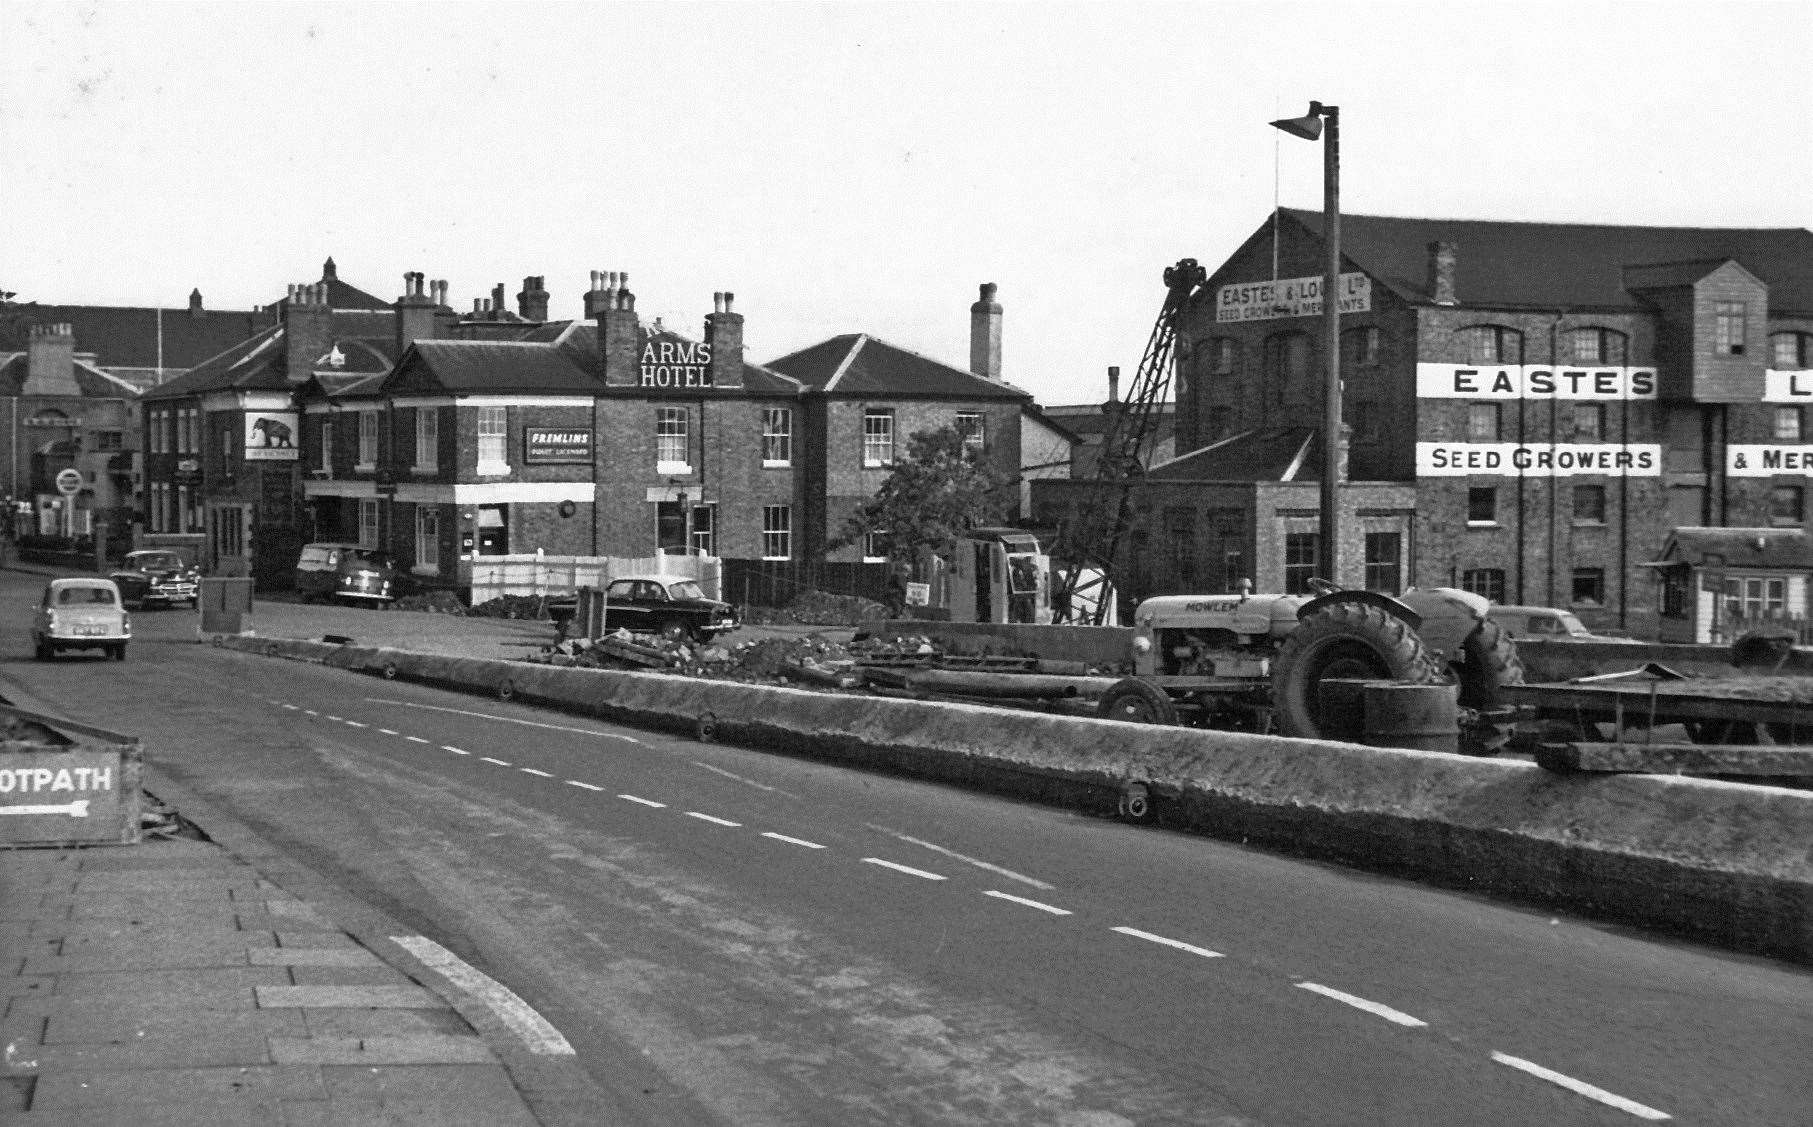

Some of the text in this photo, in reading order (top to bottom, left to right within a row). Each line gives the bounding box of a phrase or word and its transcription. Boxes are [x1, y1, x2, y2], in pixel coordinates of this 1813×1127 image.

[640, 342, 711, 364] ARMS
[640, 365, 711, 388] HOTEL
[1454, 369, 1655, 396] EASTES
[532, 433, 589, 444] FREMLINS
[1432, 447, 1501, 469] SEED
[1512, 447, 1653, 469] GROWERS
[1734, 451, 1747, 469] &
[1185, 602, 1239, 612] MOWLEM
[0, 767, 111, 792] OTPATH
